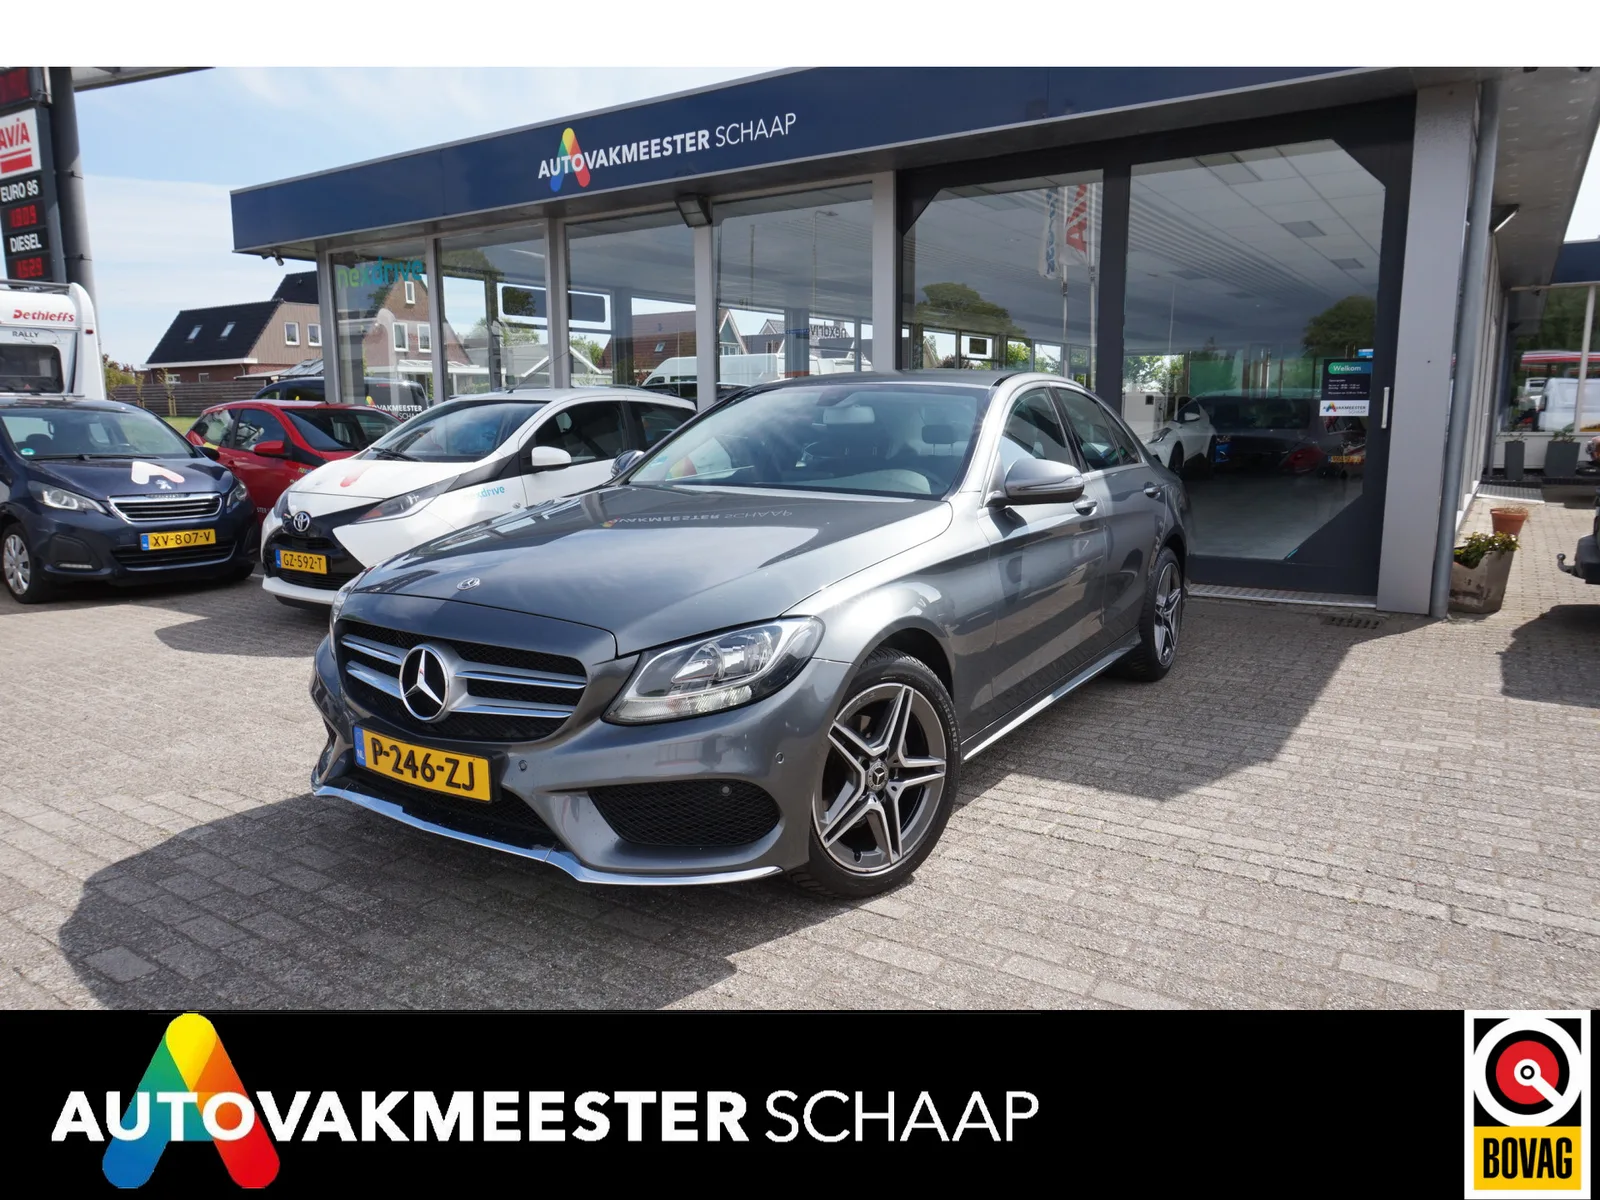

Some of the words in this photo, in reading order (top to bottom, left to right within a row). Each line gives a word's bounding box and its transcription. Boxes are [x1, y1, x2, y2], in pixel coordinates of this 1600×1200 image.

[538, 129, 710, 179] AUTOVAKMEESTER
[715, 112, 797, 147] SCHAAP
[0, 182, 26, 202] EURO
[27, 179, 39, 196] 95
[10, 233, 42, 253] DIESEL
[337, 256, 424, 290] nexdrive
[12, 309, 75, 323] Dethleffs
[1333, 364, 1361, 372] Welkom
[153, 532, 211, 547] XV-807-V
[283, 555, 323, 571] GZ-592-T
[371, 737, 475, 791] P-246-ZJ
